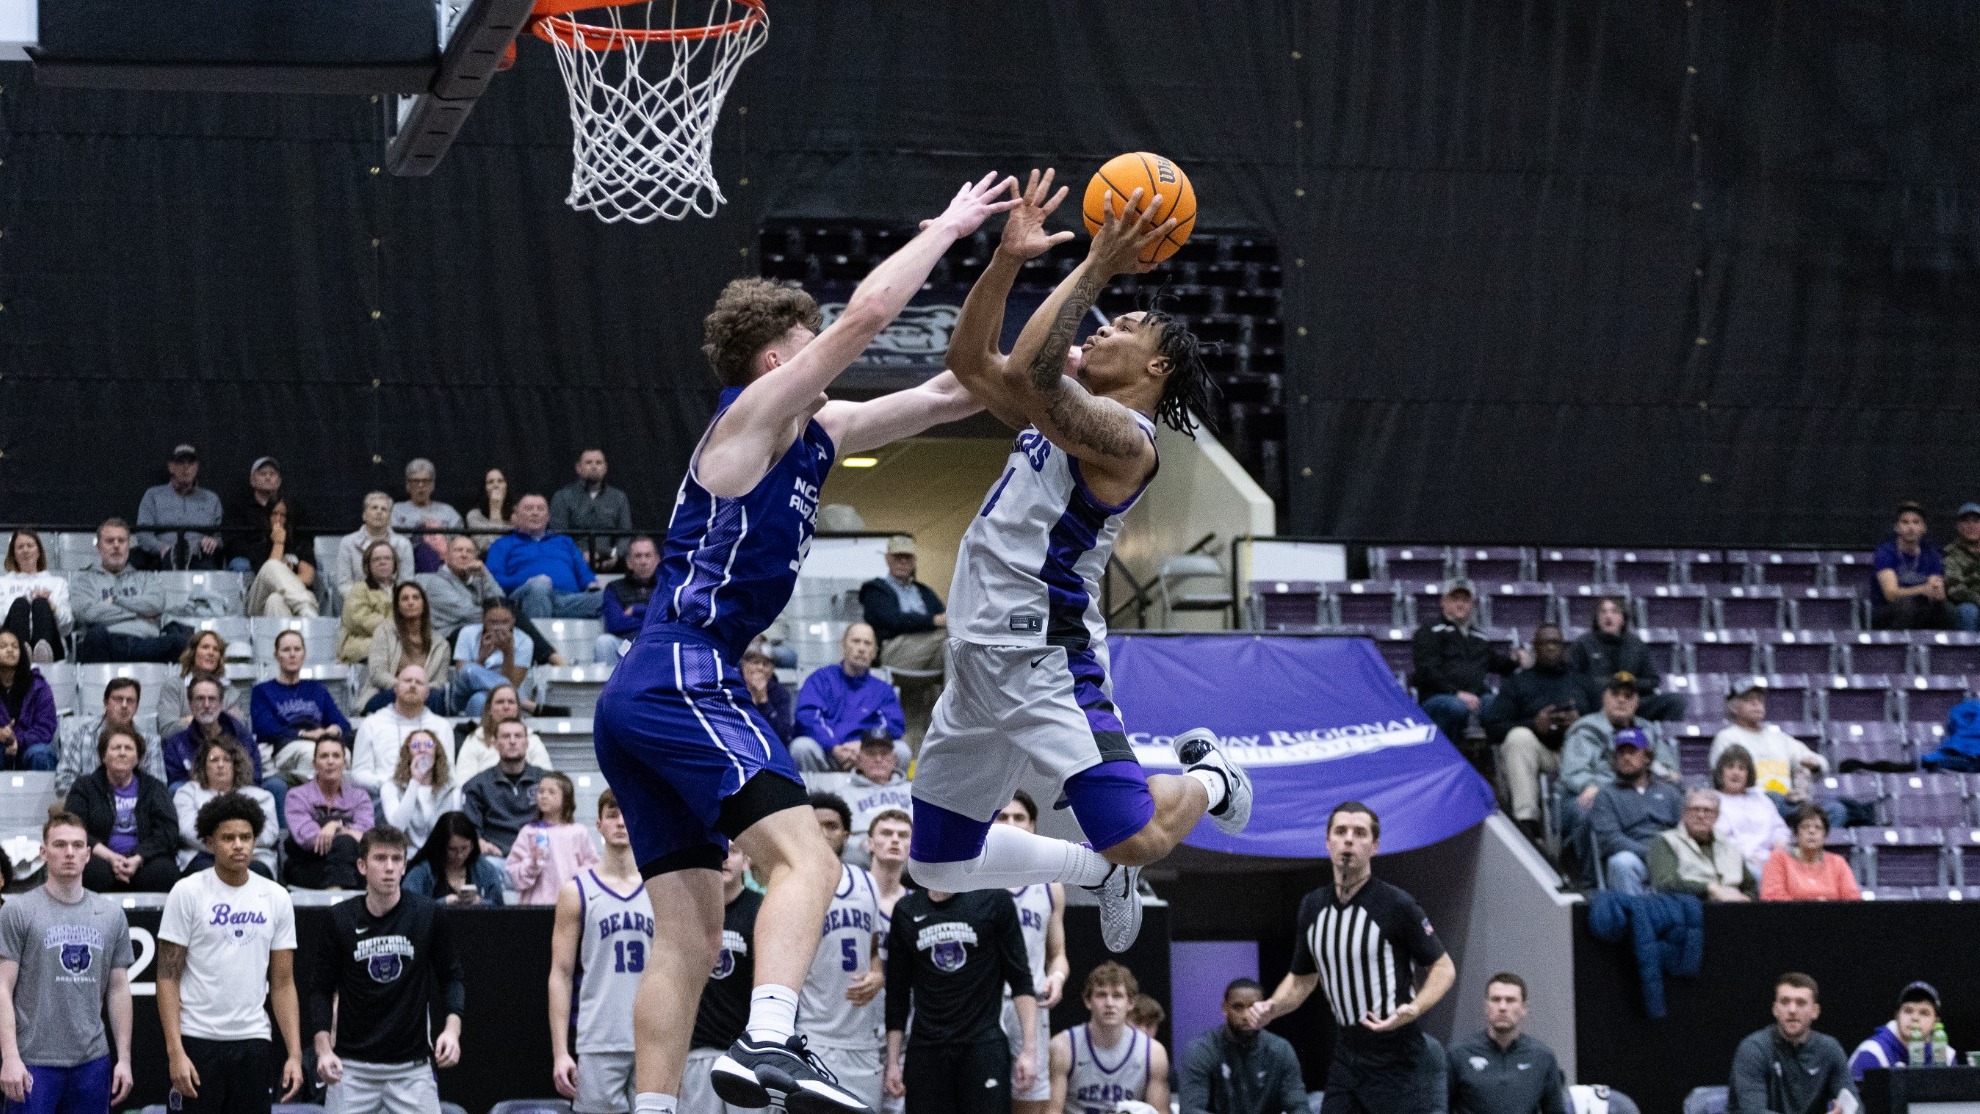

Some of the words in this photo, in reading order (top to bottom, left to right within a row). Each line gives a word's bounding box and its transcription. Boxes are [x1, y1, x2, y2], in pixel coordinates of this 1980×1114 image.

[209, 903, 267, 925] Bears
[599, 910, 655, 940] BEARS
[822, 908, 872, 938] BEARS
[614, 940, 645, 973] 13
[841, 938, 858, 972] 5
